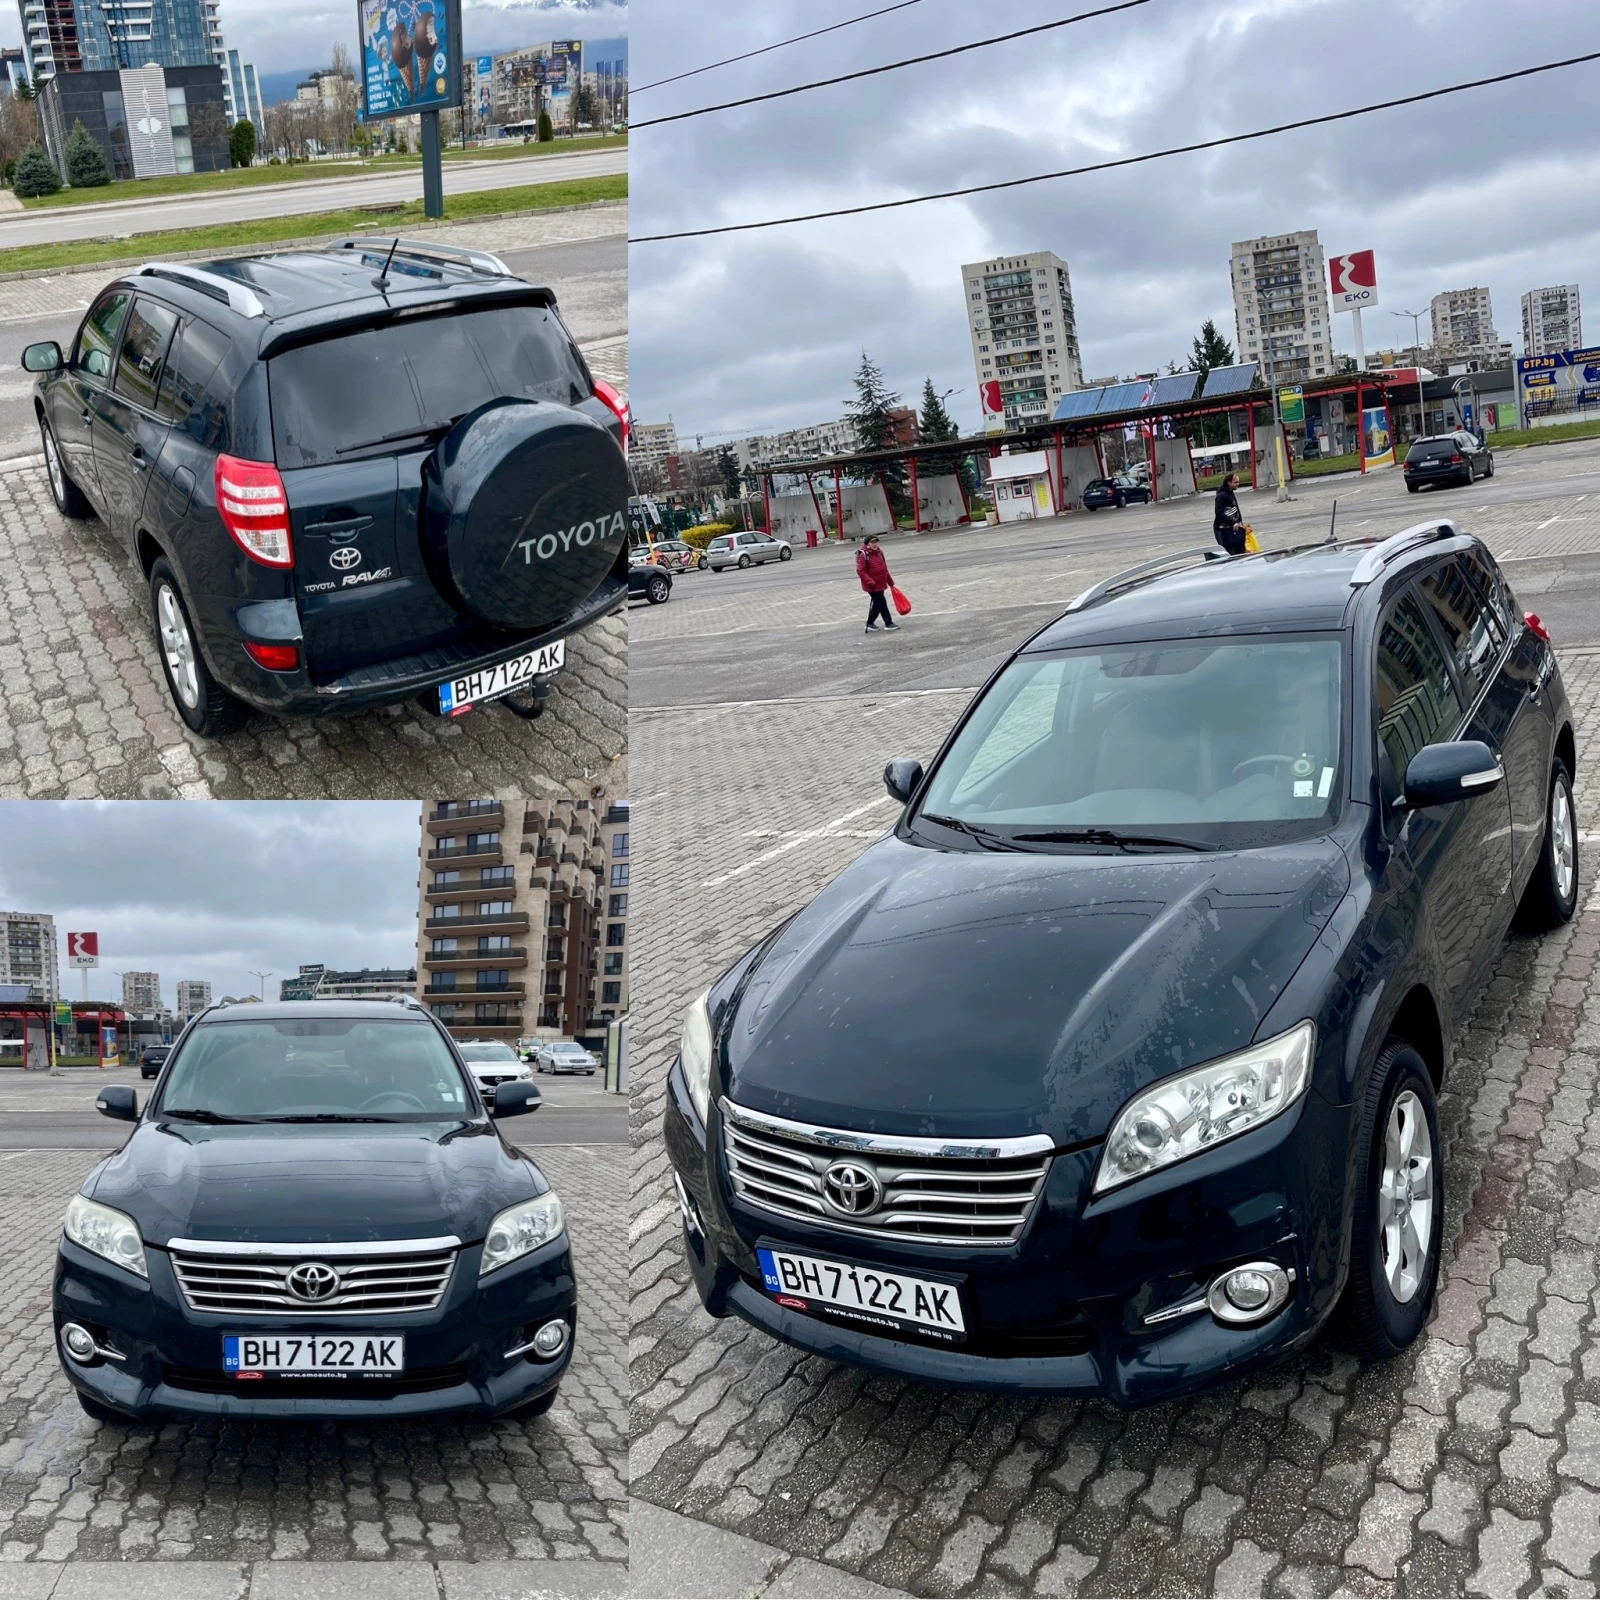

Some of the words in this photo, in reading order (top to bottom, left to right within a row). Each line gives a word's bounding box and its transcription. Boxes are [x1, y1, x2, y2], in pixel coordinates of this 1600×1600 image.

[1344, 290, 1370, 302] EKO
[1523, 358, 1555, 369] GTP.bg
[518, 510, 627, 564] TOYOTA
[304, 582, 336, 592] TOYOTA
[342, 567, 392, 587] RAV4
[442, 699, 452, 708] BG
[765, 1274, 778, 1286] BG
[824, 1306, 901, 1330] www.emoauto.bg
[226, 1357, 238, 1366] BG
